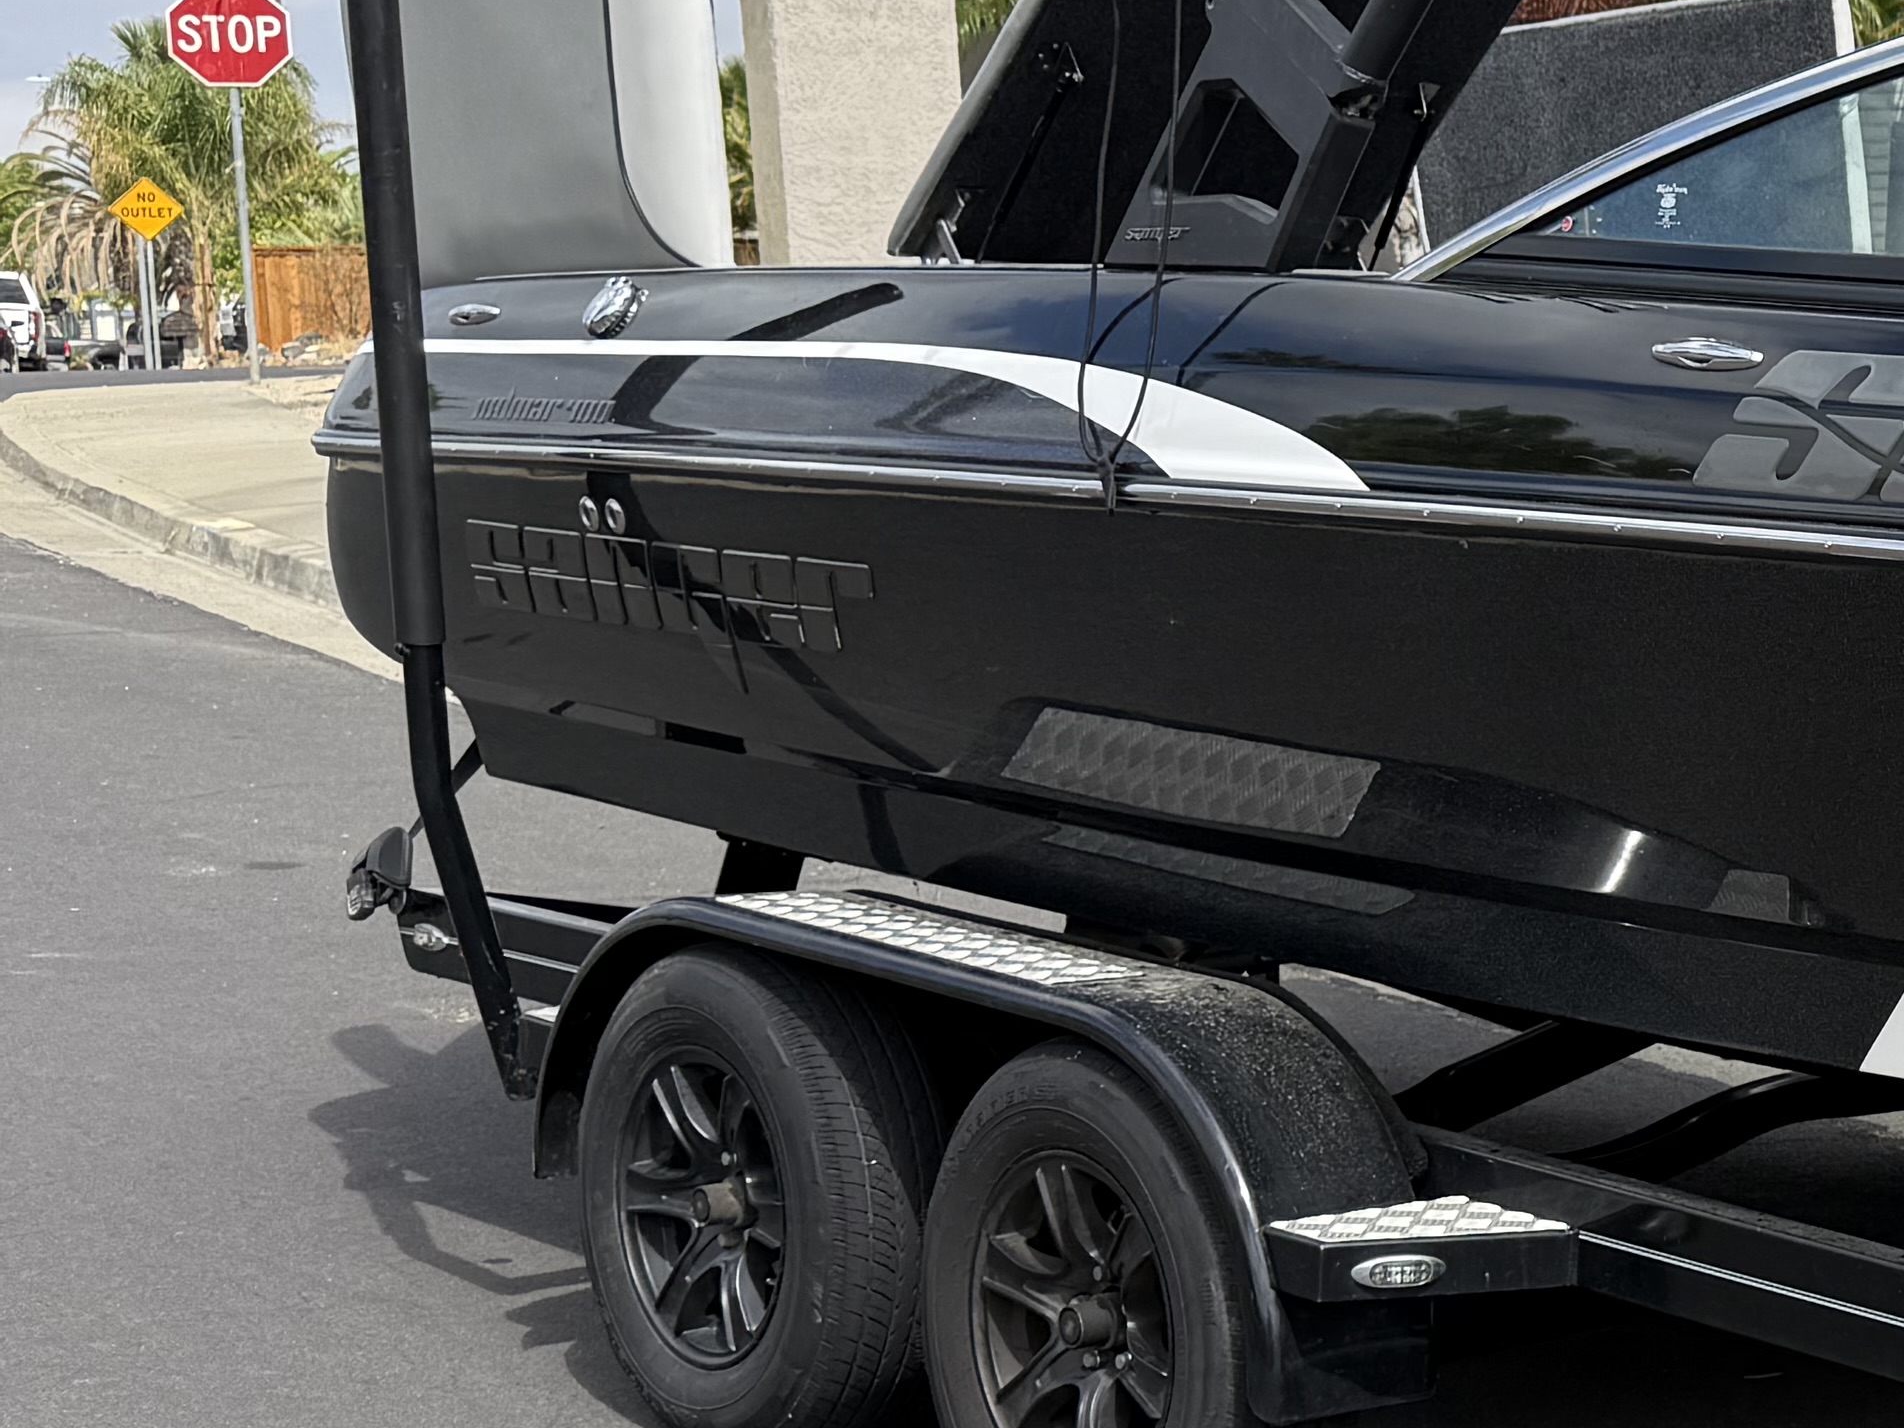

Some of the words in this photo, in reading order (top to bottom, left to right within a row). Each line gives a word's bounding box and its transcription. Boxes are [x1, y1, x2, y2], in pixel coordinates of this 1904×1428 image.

[176, 14, 281, 54] STOP
[136, 191, 156, 203] NO
[120, 206, 173, 219] OUTLET
